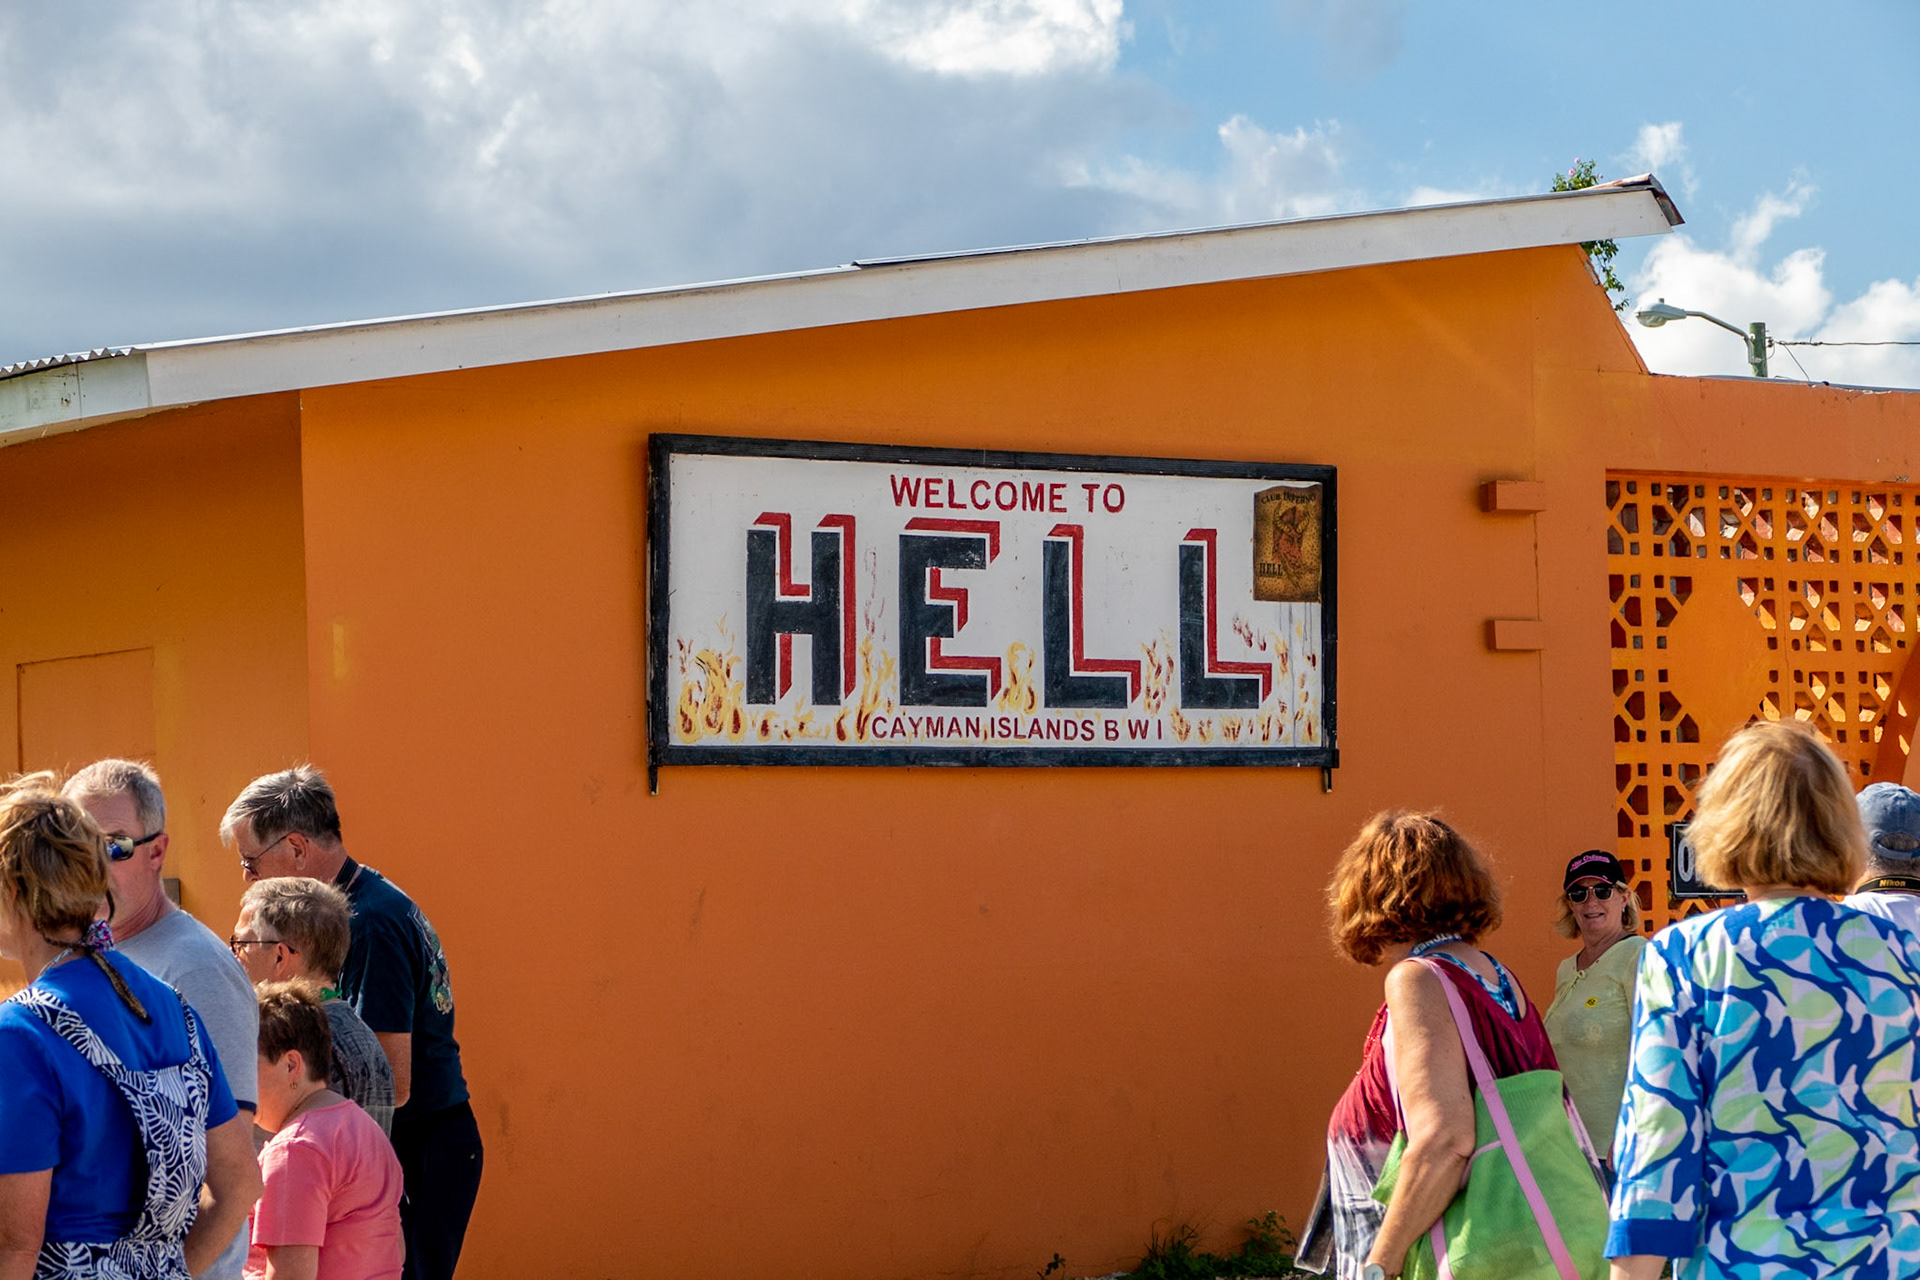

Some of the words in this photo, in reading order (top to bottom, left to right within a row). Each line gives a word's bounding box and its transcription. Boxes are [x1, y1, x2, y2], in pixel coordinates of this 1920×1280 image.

[890, 474, 1068, 513] WELCOME
[1081, 483, 1125, 513] TO
[1261, 493, 1281, 504] CLUB
[1259, 562, 1283, 577] HELL
[746, 512, 1272, 709] HELL
[990, 717, 1095, 741] ISLANDS
[1879, 879, 1906, 887] Nikon
